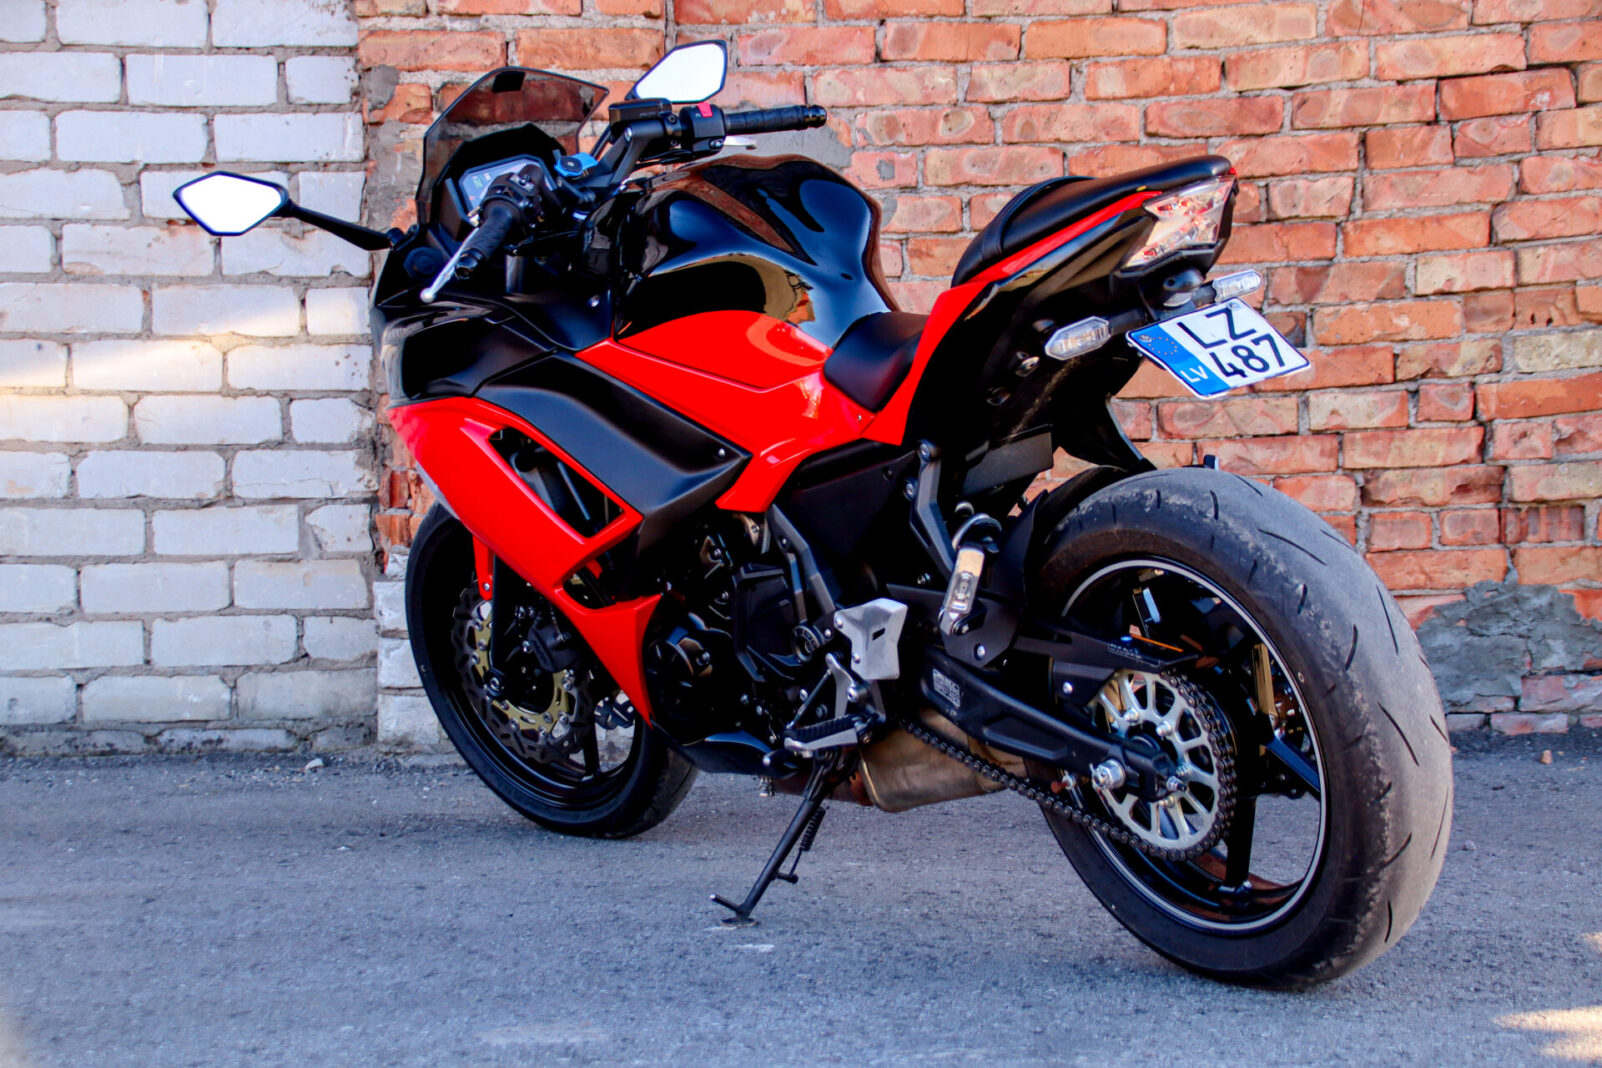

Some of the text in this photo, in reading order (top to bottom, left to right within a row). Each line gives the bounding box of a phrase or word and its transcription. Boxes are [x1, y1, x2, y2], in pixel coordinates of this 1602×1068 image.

[1176, 307, 1257, 349] LZ
[1180, 365, 1209, 383] LV
[1209, 333, 1286, 378] 487
